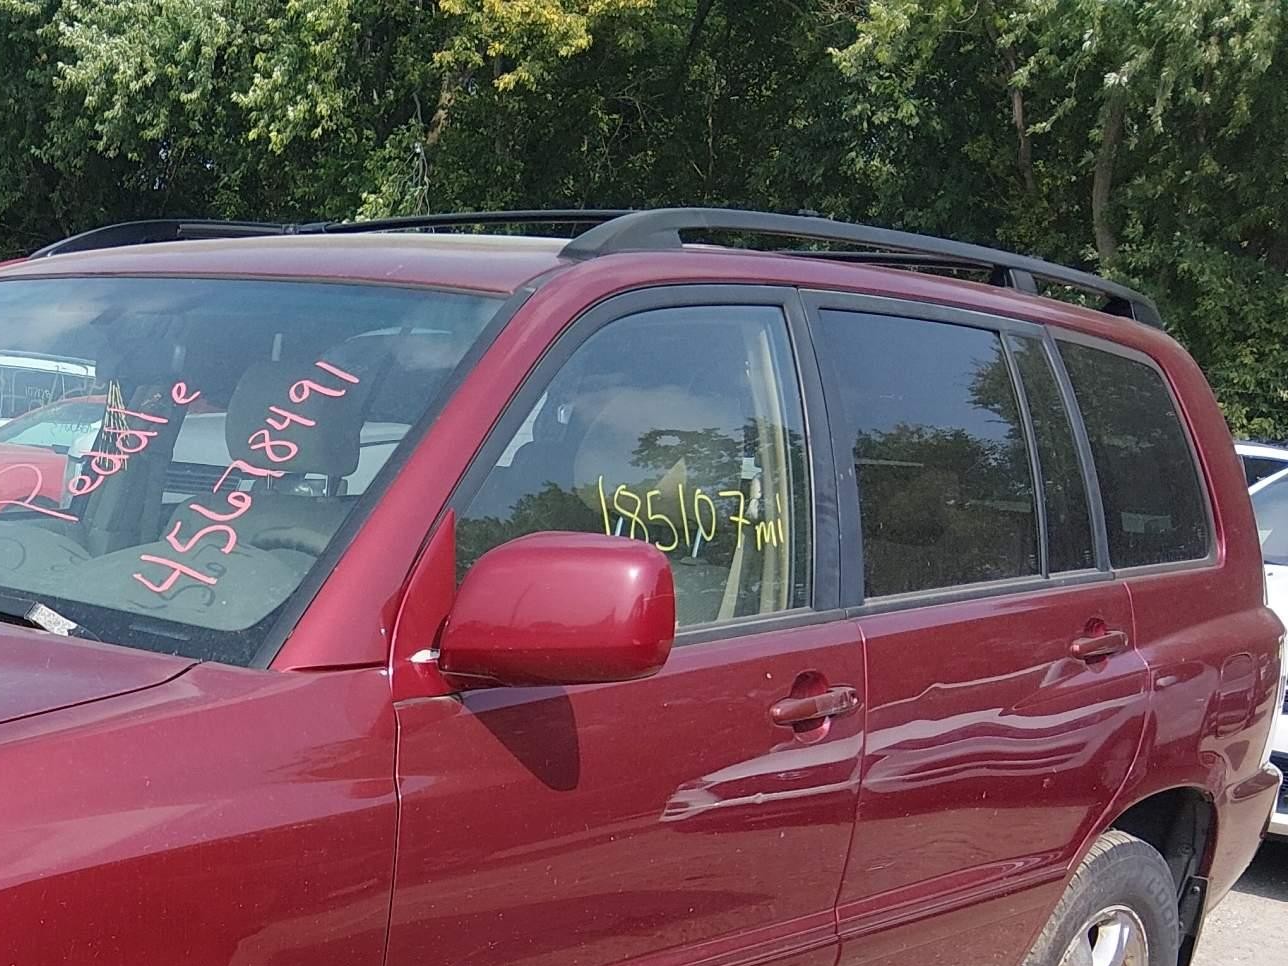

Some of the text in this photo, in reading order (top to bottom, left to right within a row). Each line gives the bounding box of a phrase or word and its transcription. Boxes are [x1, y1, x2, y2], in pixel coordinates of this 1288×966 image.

[132, 360, 360, 593] 45678491
[598, 475, 784, 552] 185107 mi
